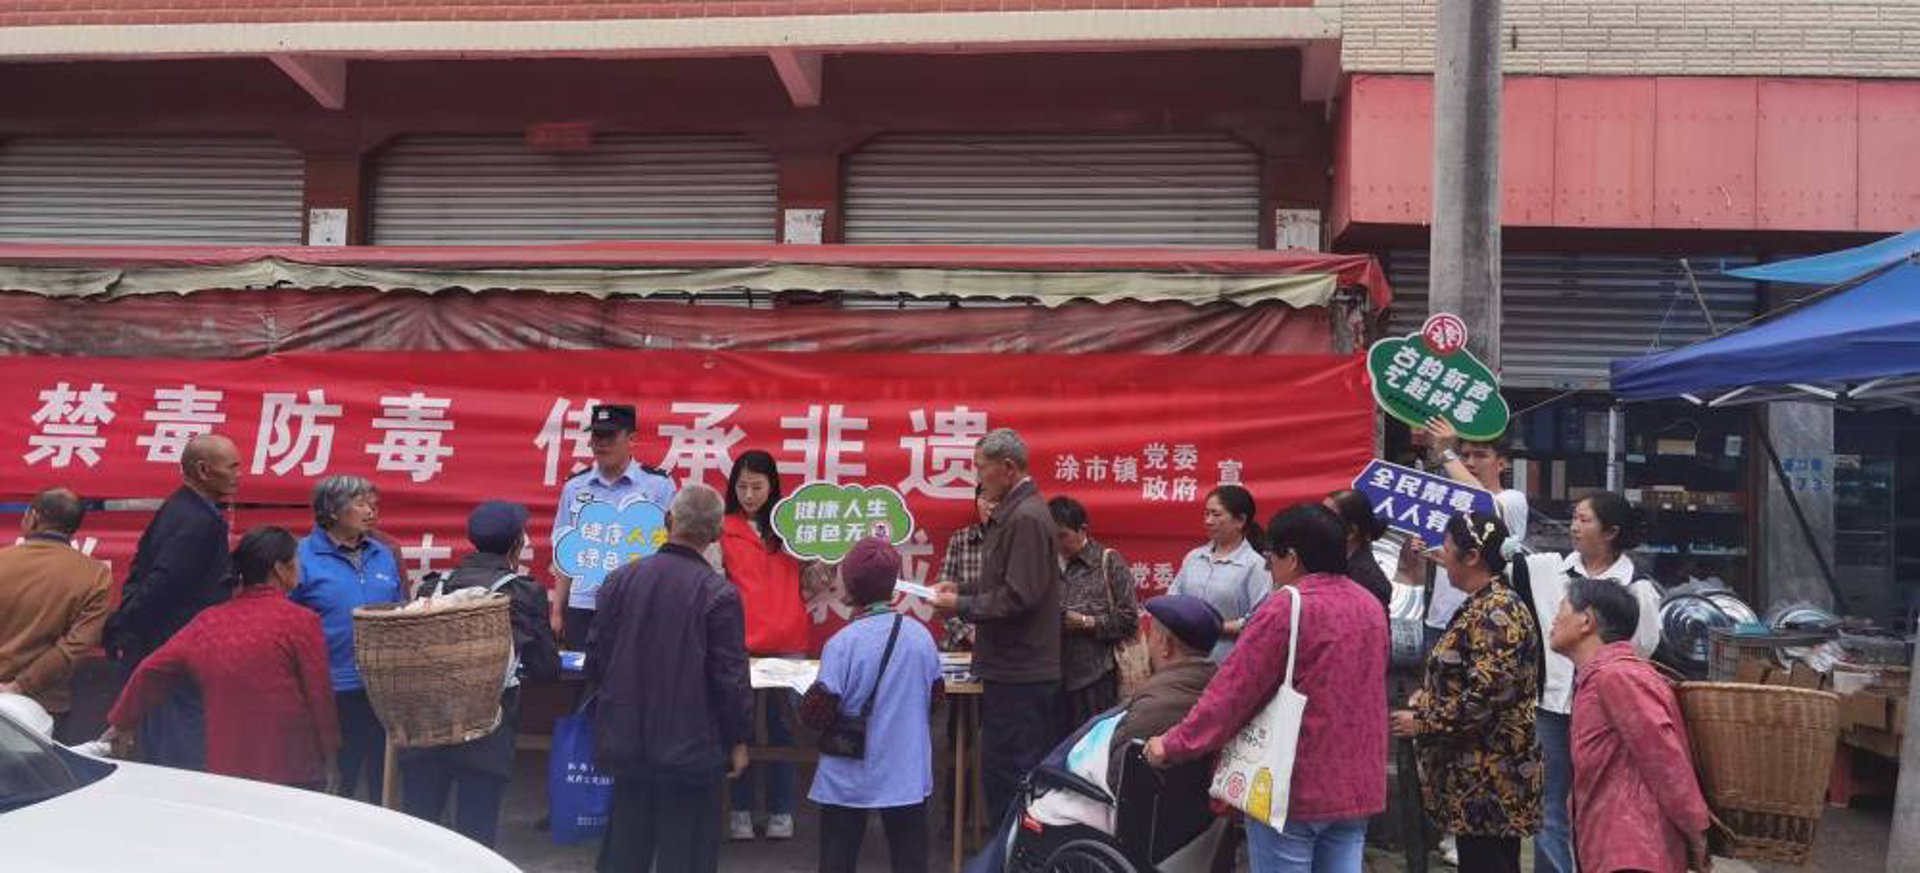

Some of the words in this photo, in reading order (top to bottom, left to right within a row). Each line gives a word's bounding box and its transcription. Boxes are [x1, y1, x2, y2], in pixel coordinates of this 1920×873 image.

[1393, 345, 1494, 402] 古韵新声
[1384, 364, 1480, 423] 艺起防毒
[23, 382, 455, 483] 禁毒防毒
[534, 397, 988, 500] 传承非遗
[1055, 454, 1139, 482] 涂市镇
[1144, 443, 1198, 471] 党委
[1217, 459, 1244, 486] 宣
[1142, 476, 1198, 501] 政府
[1369, 467, 1475, 512] 全民禁毒
[794, 499, 887, 520] 健康人生
